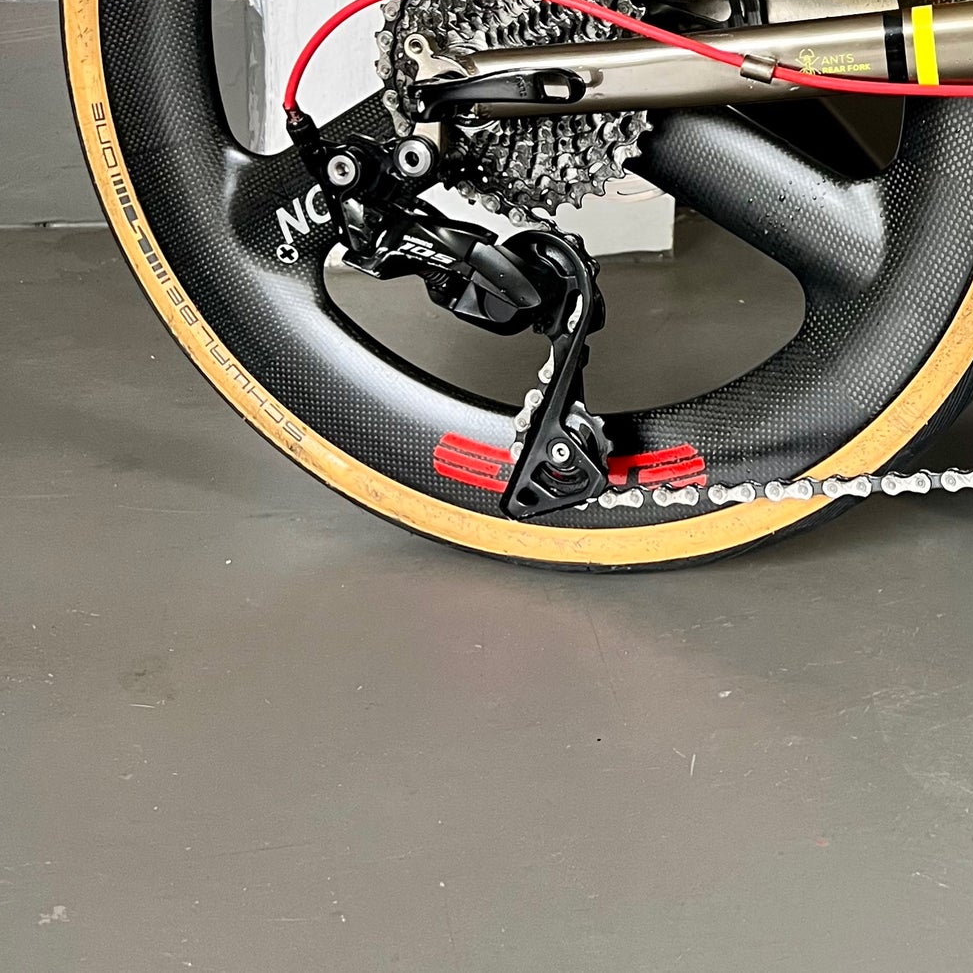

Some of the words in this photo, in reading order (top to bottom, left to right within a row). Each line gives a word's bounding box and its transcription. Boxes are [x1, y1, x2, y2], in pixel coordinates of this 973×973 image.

[821, 53, 855, 65] ANTS
[821, 65, 846, 74] REAR
[847, 63, 871, 72] FORK
[91, 102, 118, 169] ONE
[166, 285, 307, 443] SCHWALBE
